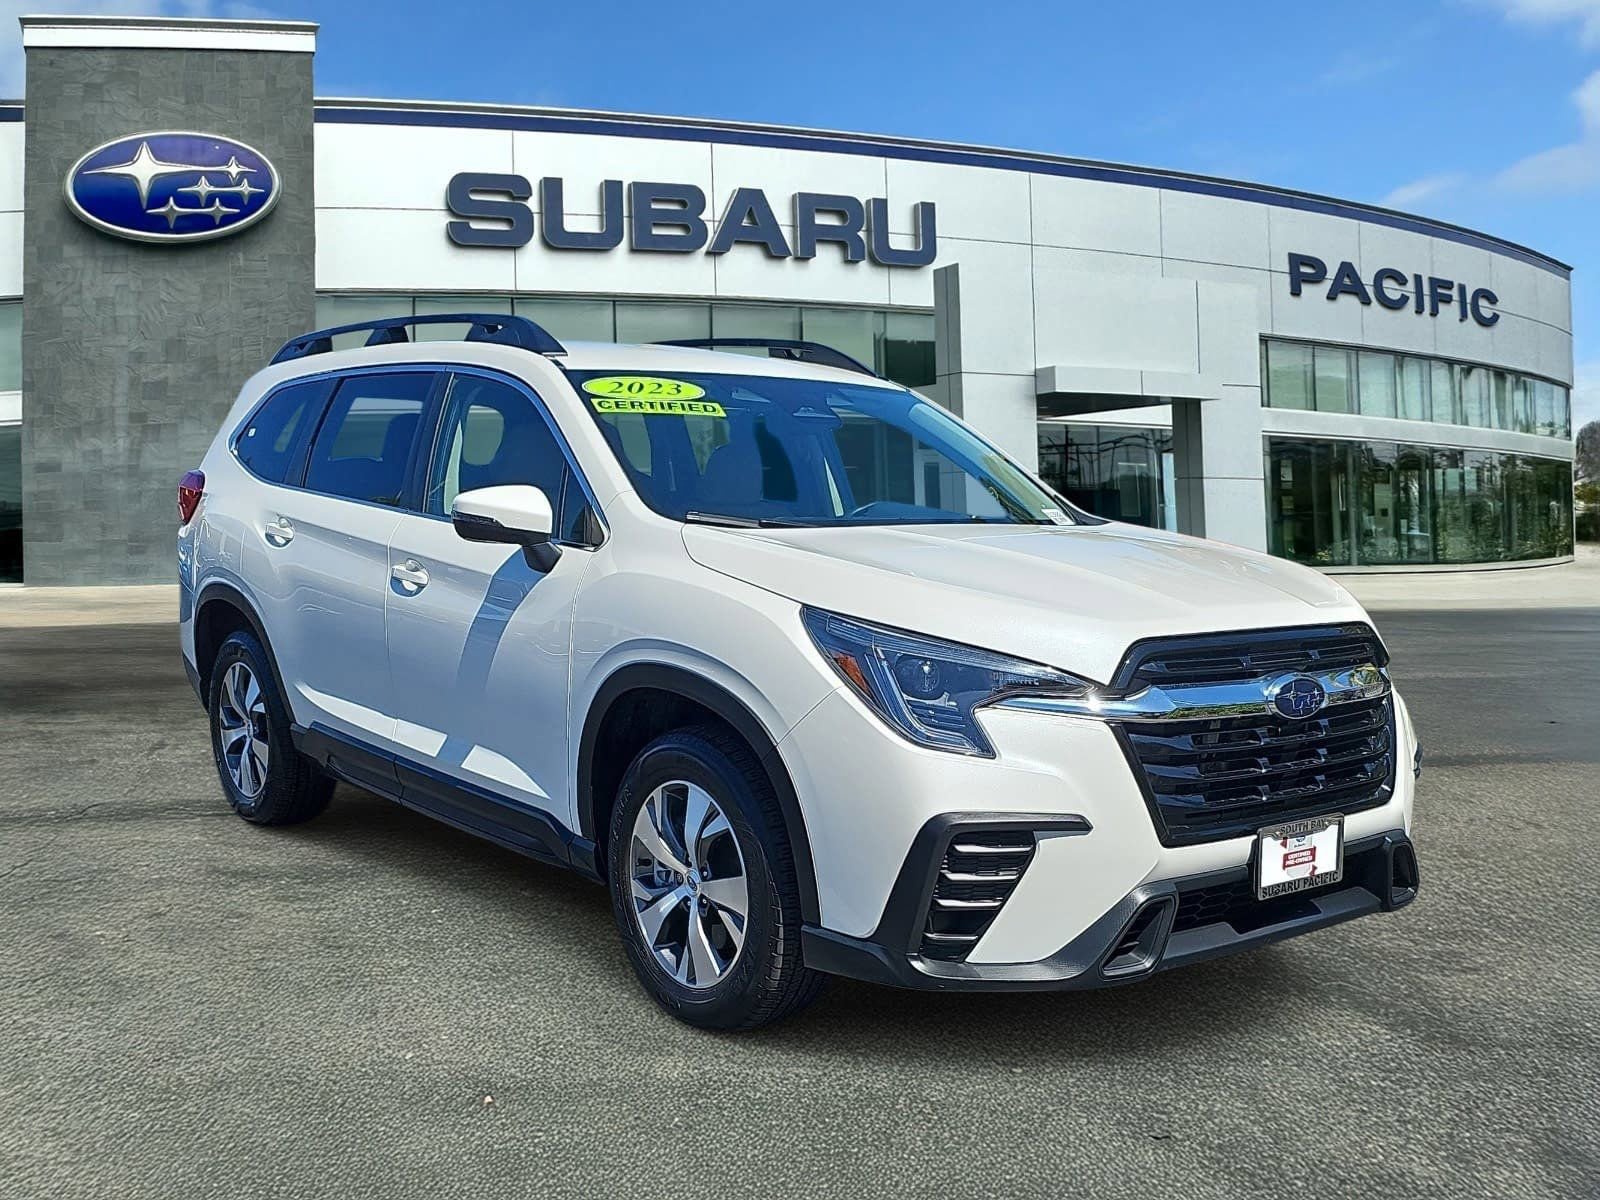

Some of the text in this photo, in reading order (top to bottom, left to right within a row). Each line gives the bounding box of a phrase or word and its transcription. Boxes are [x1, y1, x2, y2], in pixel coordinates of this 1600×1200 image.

[446, 171, 937, 267] SUBARU
[1288, 252, 1500, 327] PACIFIC
[607, 381, 682, 396] 2023
[597, 400, 717, 413] CERTIFIED
[1280, 821, 1309, 834] SOUTH
[1262, 871, 1338, 898] SUBARU PACIFIC
